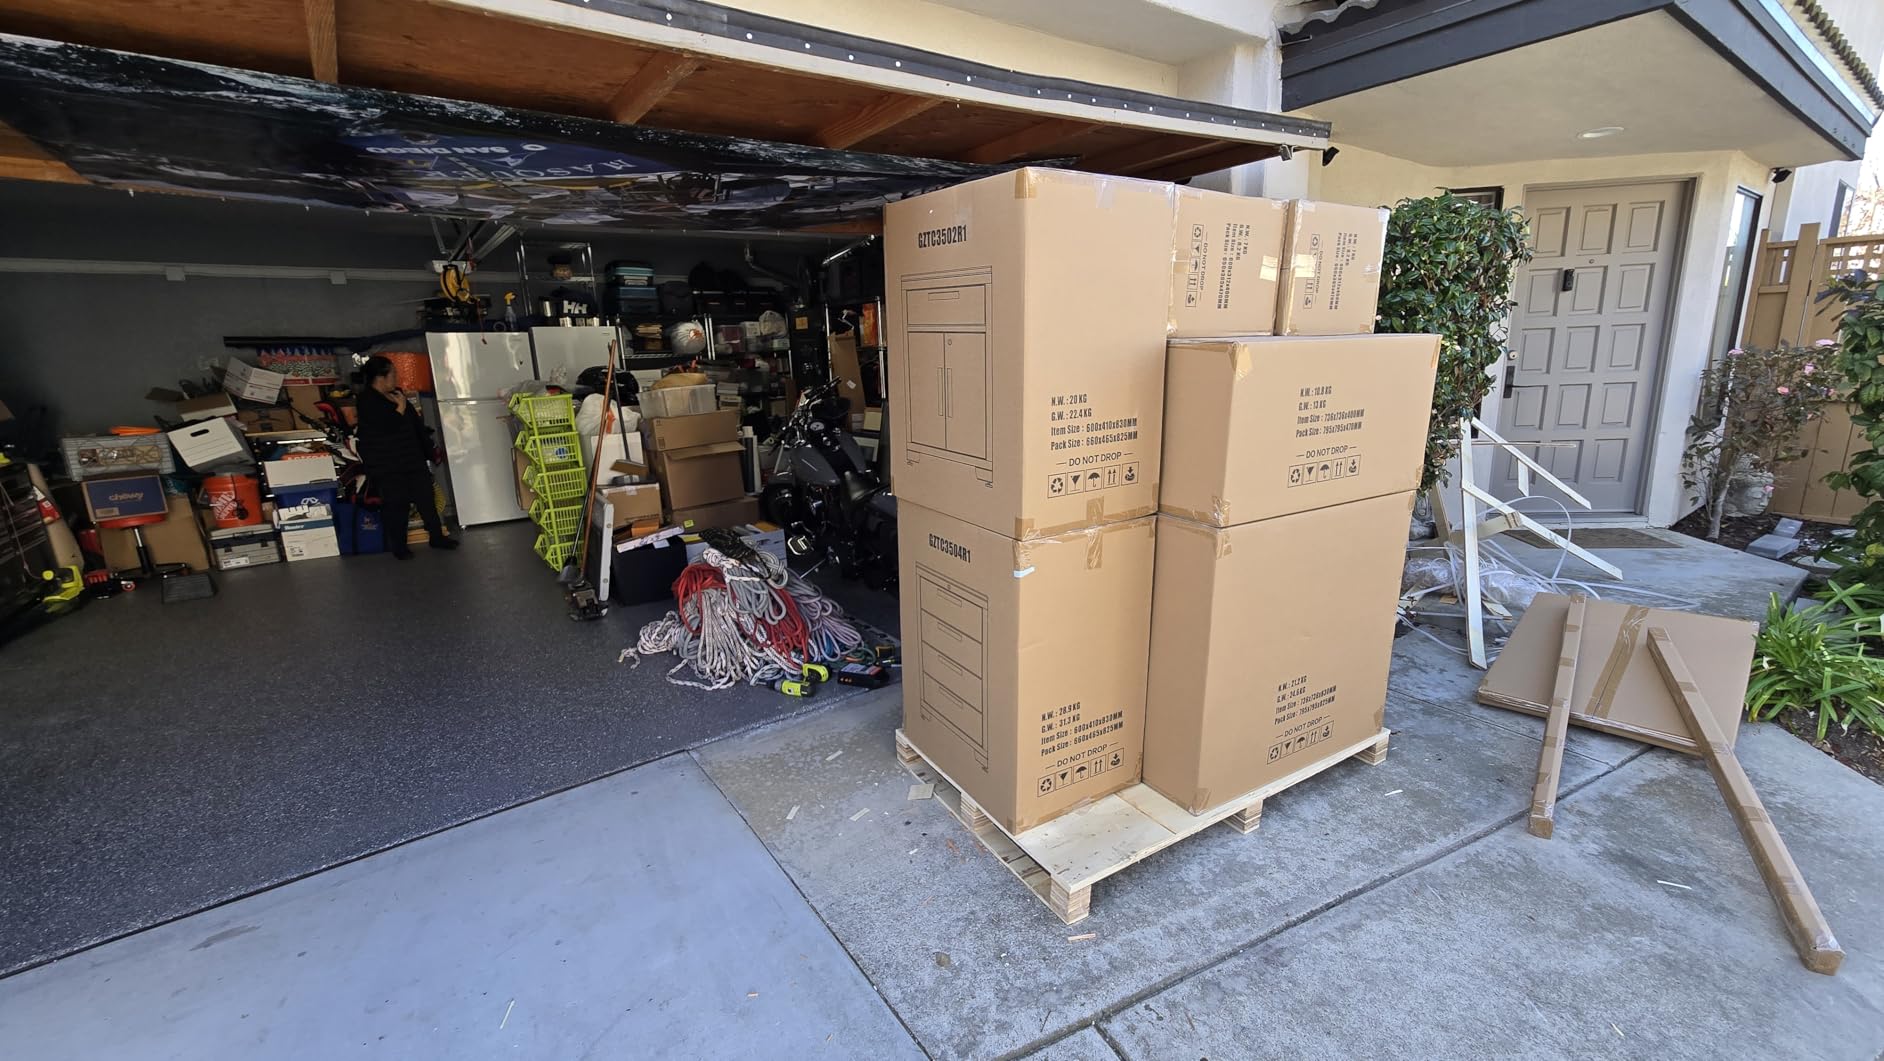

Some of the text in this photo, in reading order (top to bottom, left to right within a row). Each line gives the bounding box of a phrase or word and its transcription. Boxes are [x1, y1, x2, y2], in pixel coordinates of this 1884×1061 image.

[365, 146, 509, 154] SAN DIEGO
[918, 224, 967, 249] GZTC3502R1
[1203, 243, 1208, 253] DO
[1319, 251, 1323, 260] DO
[1300, 388, 1310, 397] N.W.
[1325, 386, 1332, 394] KG
[1051, 396, 1065, 406] N.W.
[1070, 395, 1077, 404] 20
[1079, 394, 1087, 403] KG
[1299, 402, 1309, 411] G.W.
[1320, 400, 1326, 408] KG
[1052, 411, 1065, 421] G.W.
[1070, 409, 1082, 419] 22.4
[1084, 408, 1092, 417] KG
[1310, 415, 1320, 423] Size
[1051, 427, 1066, 436] Item
[1068, 425, 1080, 434] Size
[1296, 429, 1308, 438] Pack
[1309, 428, 1318, 436] Size
[1051, 440, 1066, 450] Pack
[1068, 439, 1080, 448] Size
[1086, 431, 1138, 446] 660x465x825MM
[1306, 445, 1348, 458] DO NOT DROP
[1069, 452, 1121, 466] DO NOT DROP
[928, 533, 971, 564] GZTC3504R1
[1278, 683, 1288, 691] N.W.
[1042, 711, 1053, 721] N.W.
[1059, 705, 1071, 715] 28.9
[1073, 702, 1080, 711] KG
[1276, 705, 1286, 714] Item
[1288, 701, 1296, 710] Size
[1042, 724, 1053, 733] G.W.
[1073, 714, 1080, 722] KG
[1275, 716, 1286, 725] Pack
[1286, 711, 1295, 720] Size
[1285, 716, 1322, 737] DO NOT DROP
[1041, 735, 1055, 745] Item
[1056, 730, 1068, 739] Size
[1041, 746, 1055, 756] Pack
[1057, 741, 1068, 750] Size
[1057, 744, 1107, 767] DO NOT DROP
